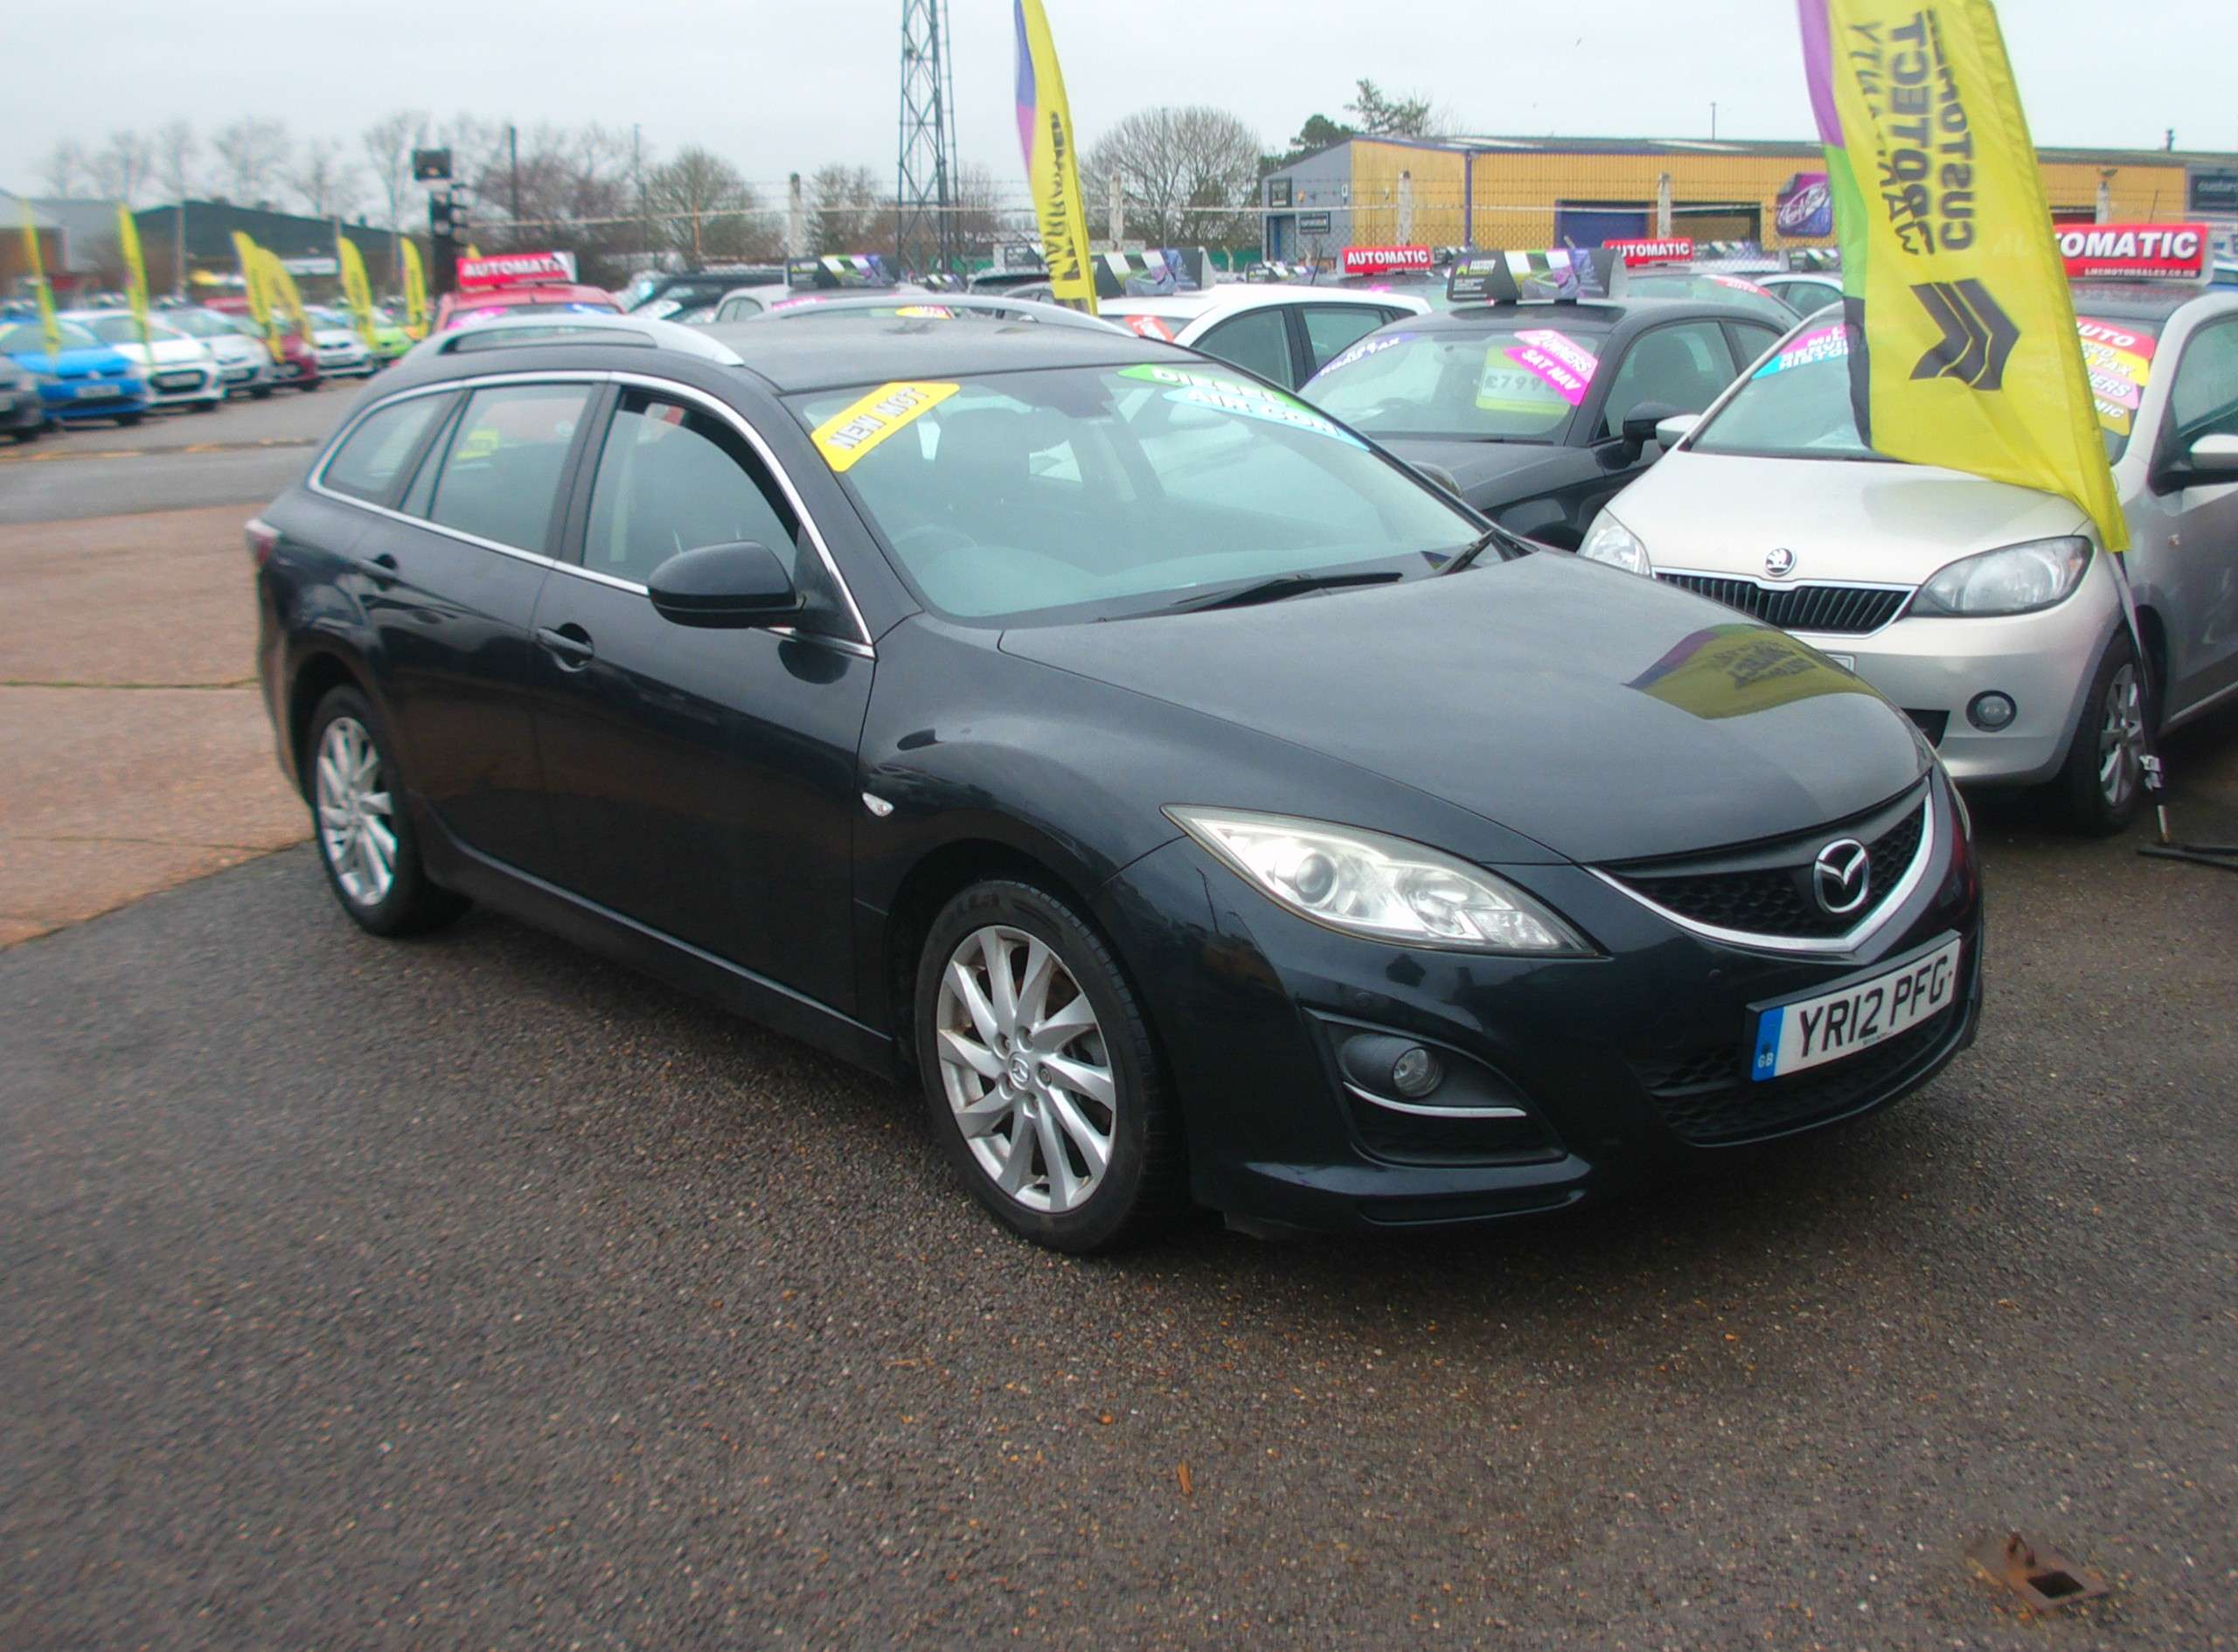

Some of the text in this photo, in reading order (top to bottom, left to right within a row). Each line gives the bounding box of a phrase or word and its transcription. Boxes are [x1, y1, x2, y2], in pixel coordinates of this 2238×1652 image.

[1347, 250, 1428, 266] AUTOMATIC
[1610, 242, 1690, 257] UTOMATIC
[2055, 232, 2198, 259] OMATIC
[2078, 322, 2136, 347] UTO
[1521, 350, 1581, 390] SAT NAV
[824, 386, 930, 451] NEW MOT
[1799, 954, 1949, 1058] YR12 PFG
[1757, 1052, 1774, 1069] GB
